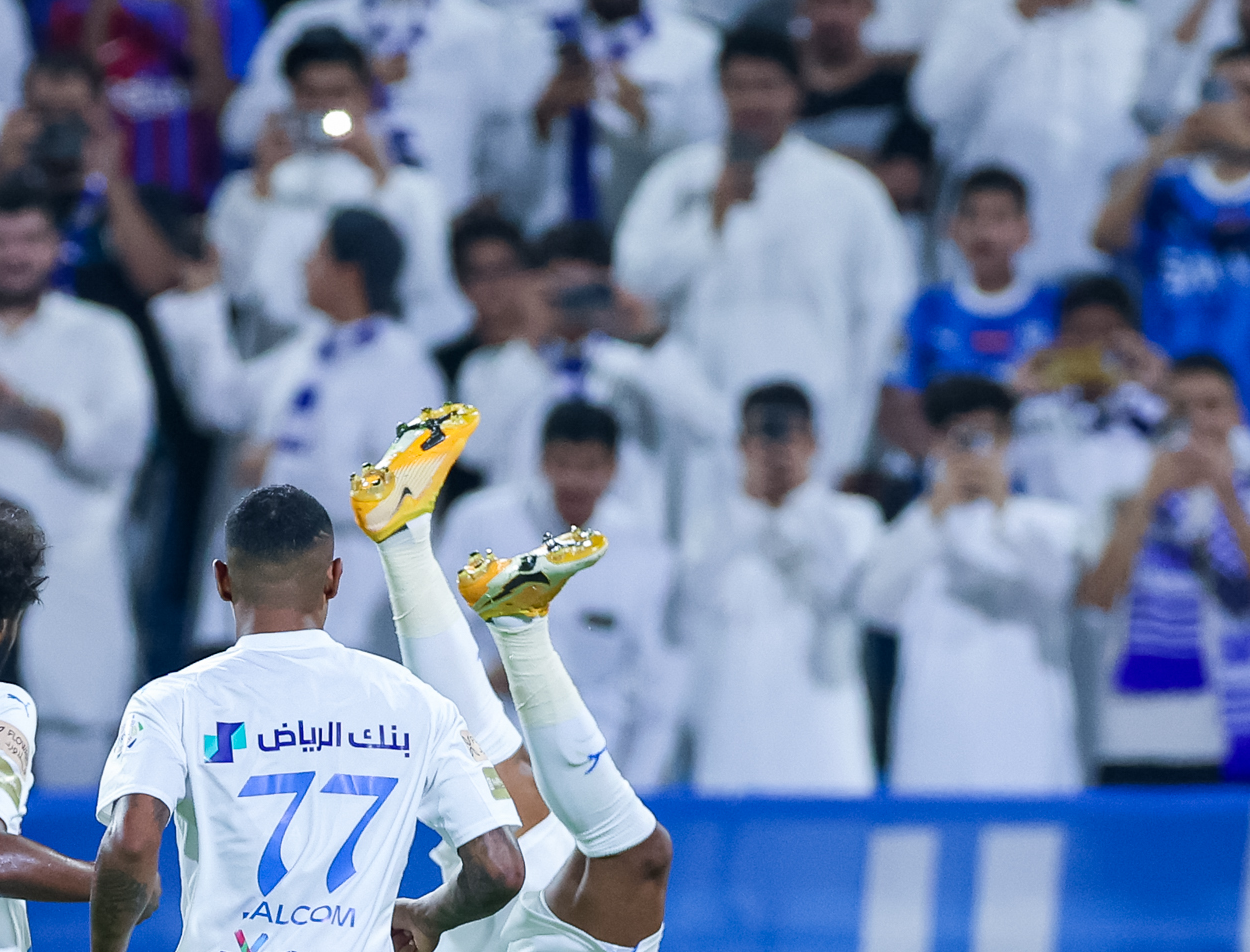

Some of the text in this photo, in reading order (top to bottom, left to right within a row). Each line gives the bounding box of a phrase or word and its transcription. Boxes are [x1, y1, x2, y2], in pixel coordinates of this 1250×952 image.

[257, 720, 411, 758] بنك الرياض
[237, 771, 399, 897] 77
[242, 900, 356, 928] ALCOM
